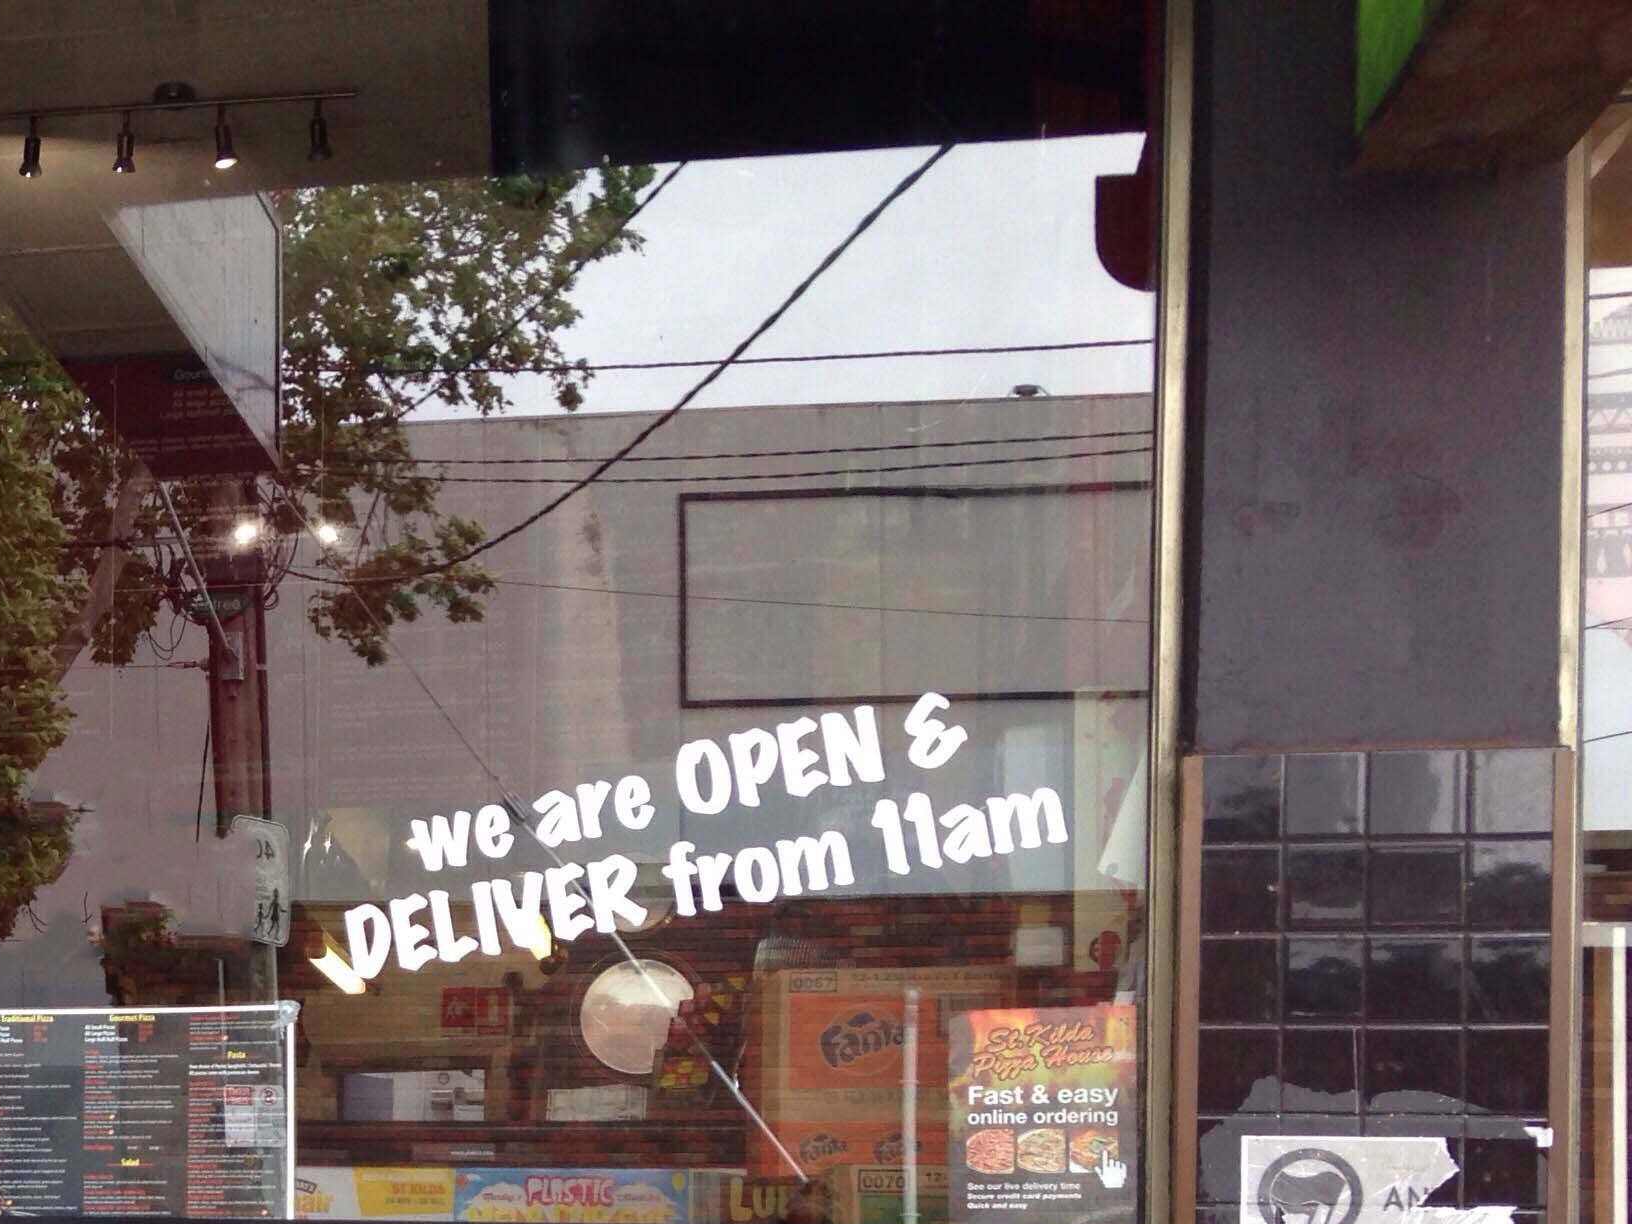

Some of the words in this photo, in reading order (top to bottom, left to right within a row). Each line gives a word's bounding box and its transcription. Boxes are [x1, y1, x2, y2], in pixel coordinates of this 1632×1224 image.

[533, 775, 656, 848] are
[676, 705, 886, 816] OPEN
[904, 691, 969, 770] &
[342, 854, 648, 982] DELIVER
[662, 820, 855, 917] from
[870, 786, 1069, 877] 11am
[1024, 1022, 1095, 1048] Kilda
[972, 1052, 1039, 1081] Pizza
[1040, 1046, 1115, 1069] House
[968, 1085, 1025, 1105] Fast
[1031, 1084, 1050, 1105] &
[1057, 1087, 1118, 1107] easy
[968, 1110, 1028, 1125] online
[1033, 1109, 1118, 1126] ordering
[967, 1183, 985, 1191] See
[1004, 1183, 1020, 1191] live
[1022, 1183, 1058, 1193] delivery
[967, 1192, 995, 1200] Secure
[996, 1192, 1020, 1200] credit
[1022, 1192, 1041, 1200] card
[1043, 1192, 1082, 1202] payments
[967, 1202, 990, 1210] Quick
[1009, 1203, 1028, 1211] easy
